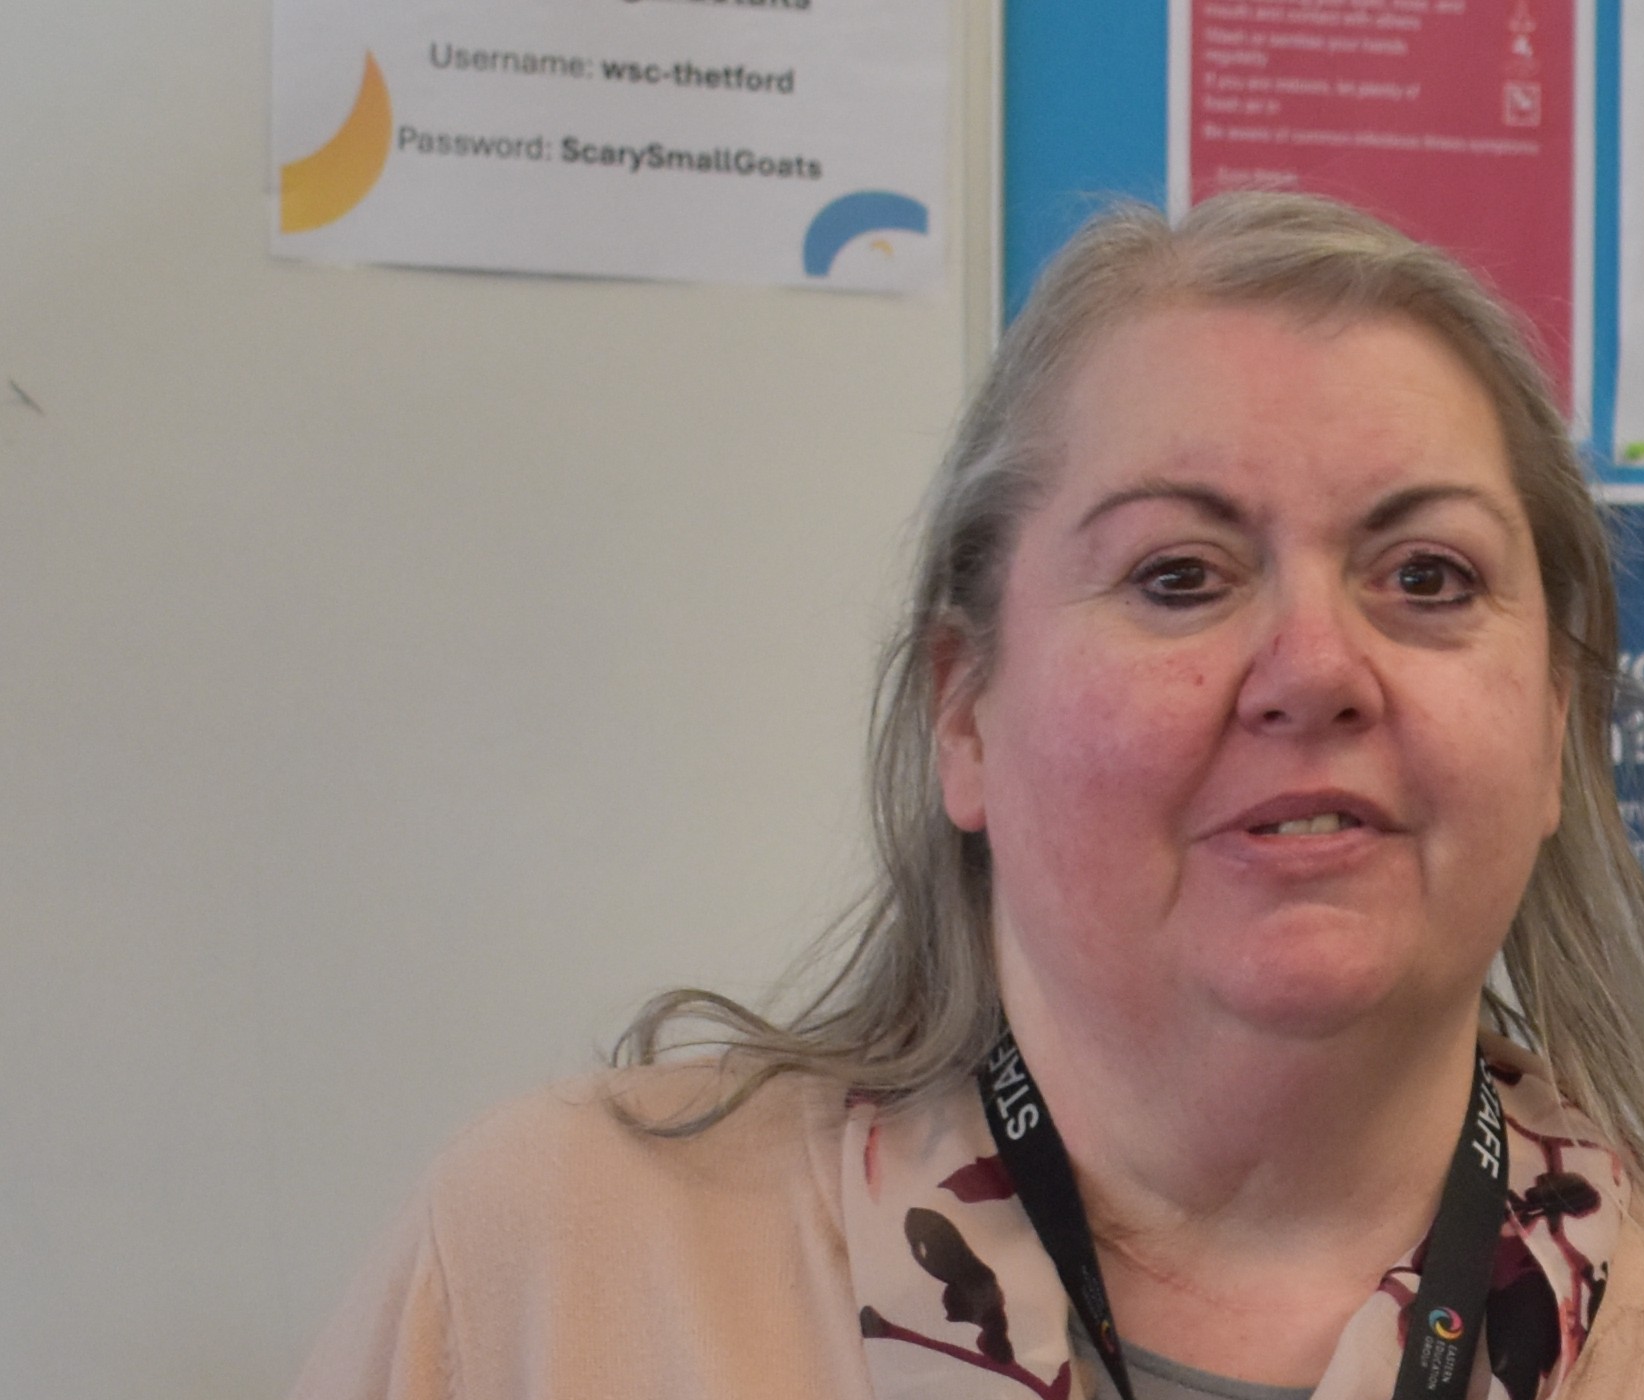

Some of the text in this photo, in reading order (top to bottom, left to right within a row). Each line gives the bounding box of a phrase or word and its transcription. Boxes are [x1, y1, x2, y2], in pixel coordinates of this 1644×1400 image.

[429, 41, 795, 96] Username: wsc-thetford
[398, 125, 823, 182] Password: ScarySmallGoats
